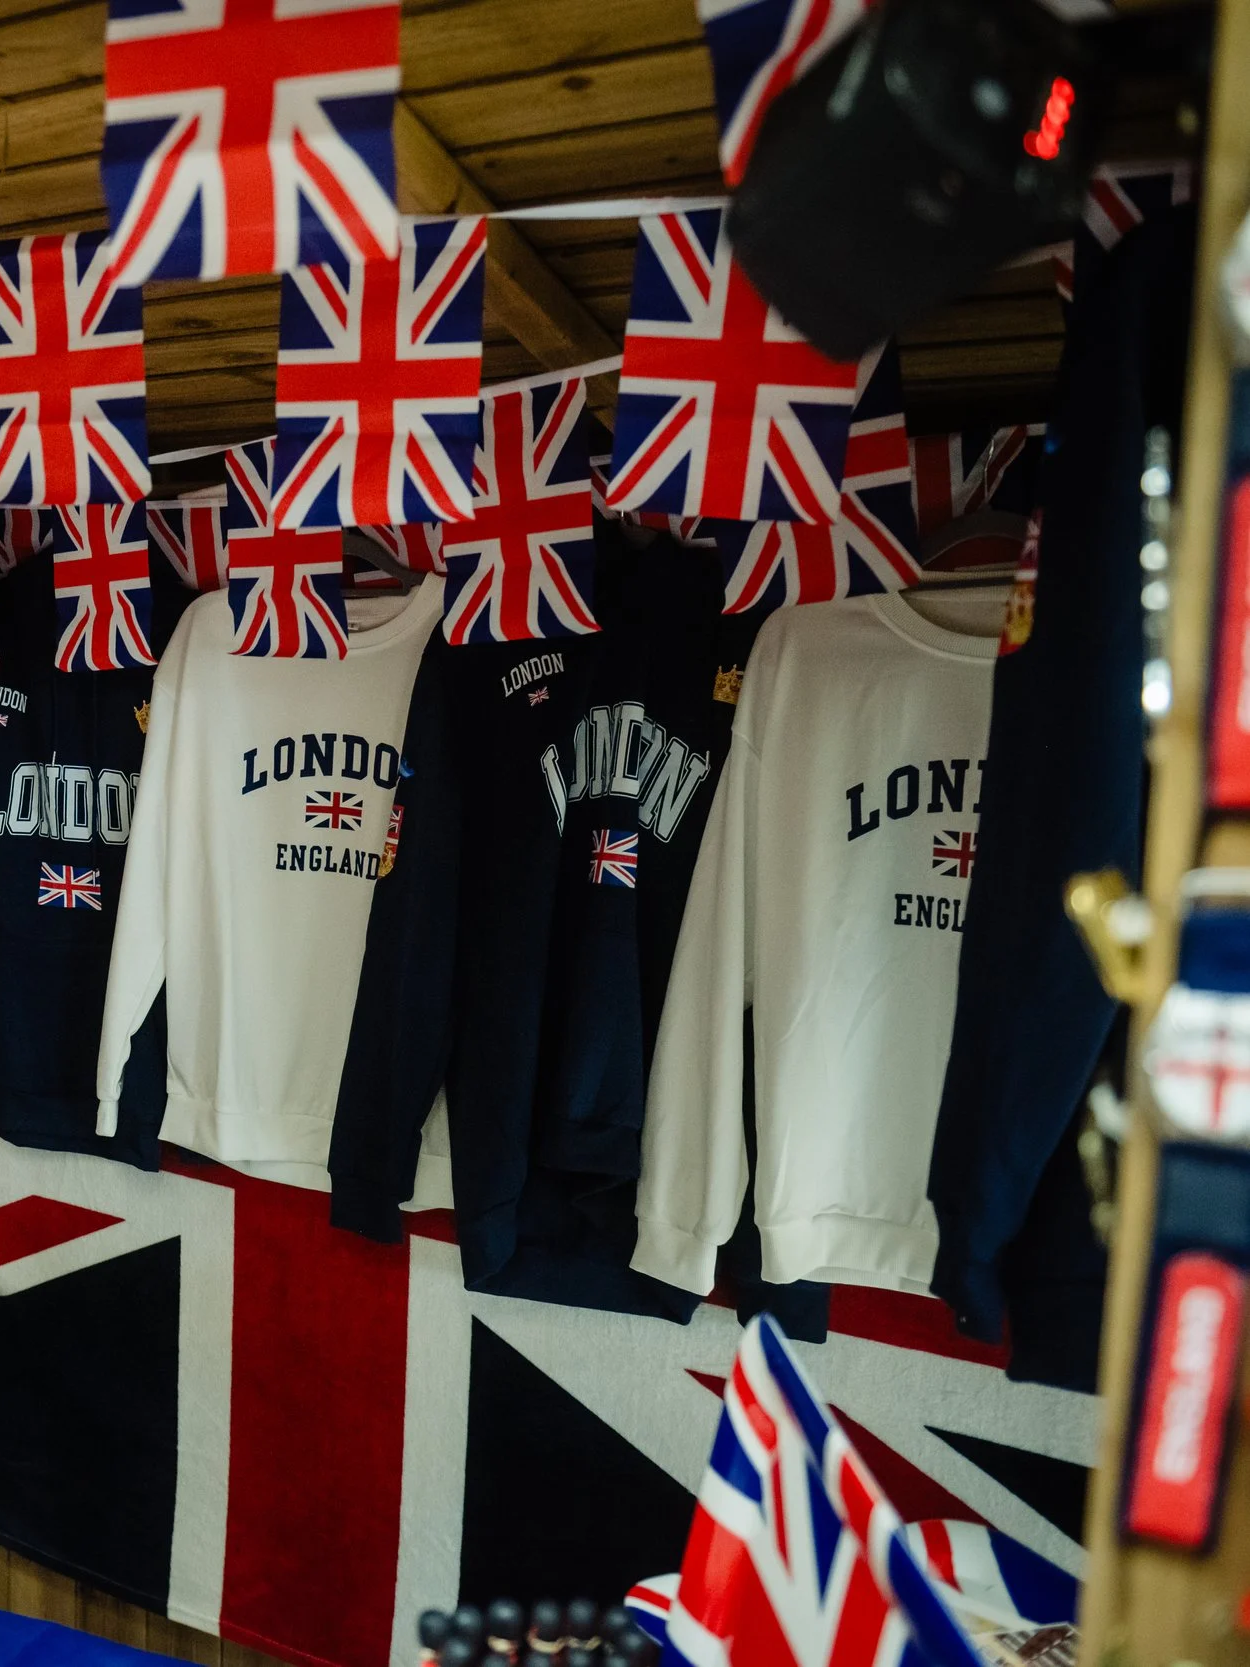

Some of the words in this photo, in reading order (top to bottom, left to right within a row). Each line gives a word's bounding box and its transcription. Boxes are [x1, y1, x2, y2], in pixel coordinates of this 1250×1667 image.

[501, 652, 565, 698] LONDON
[241, 733, 400, 796] LONDO
[275, 843, 381, 881] ENGLAND
[893, 893, 966, 933] ENGL
